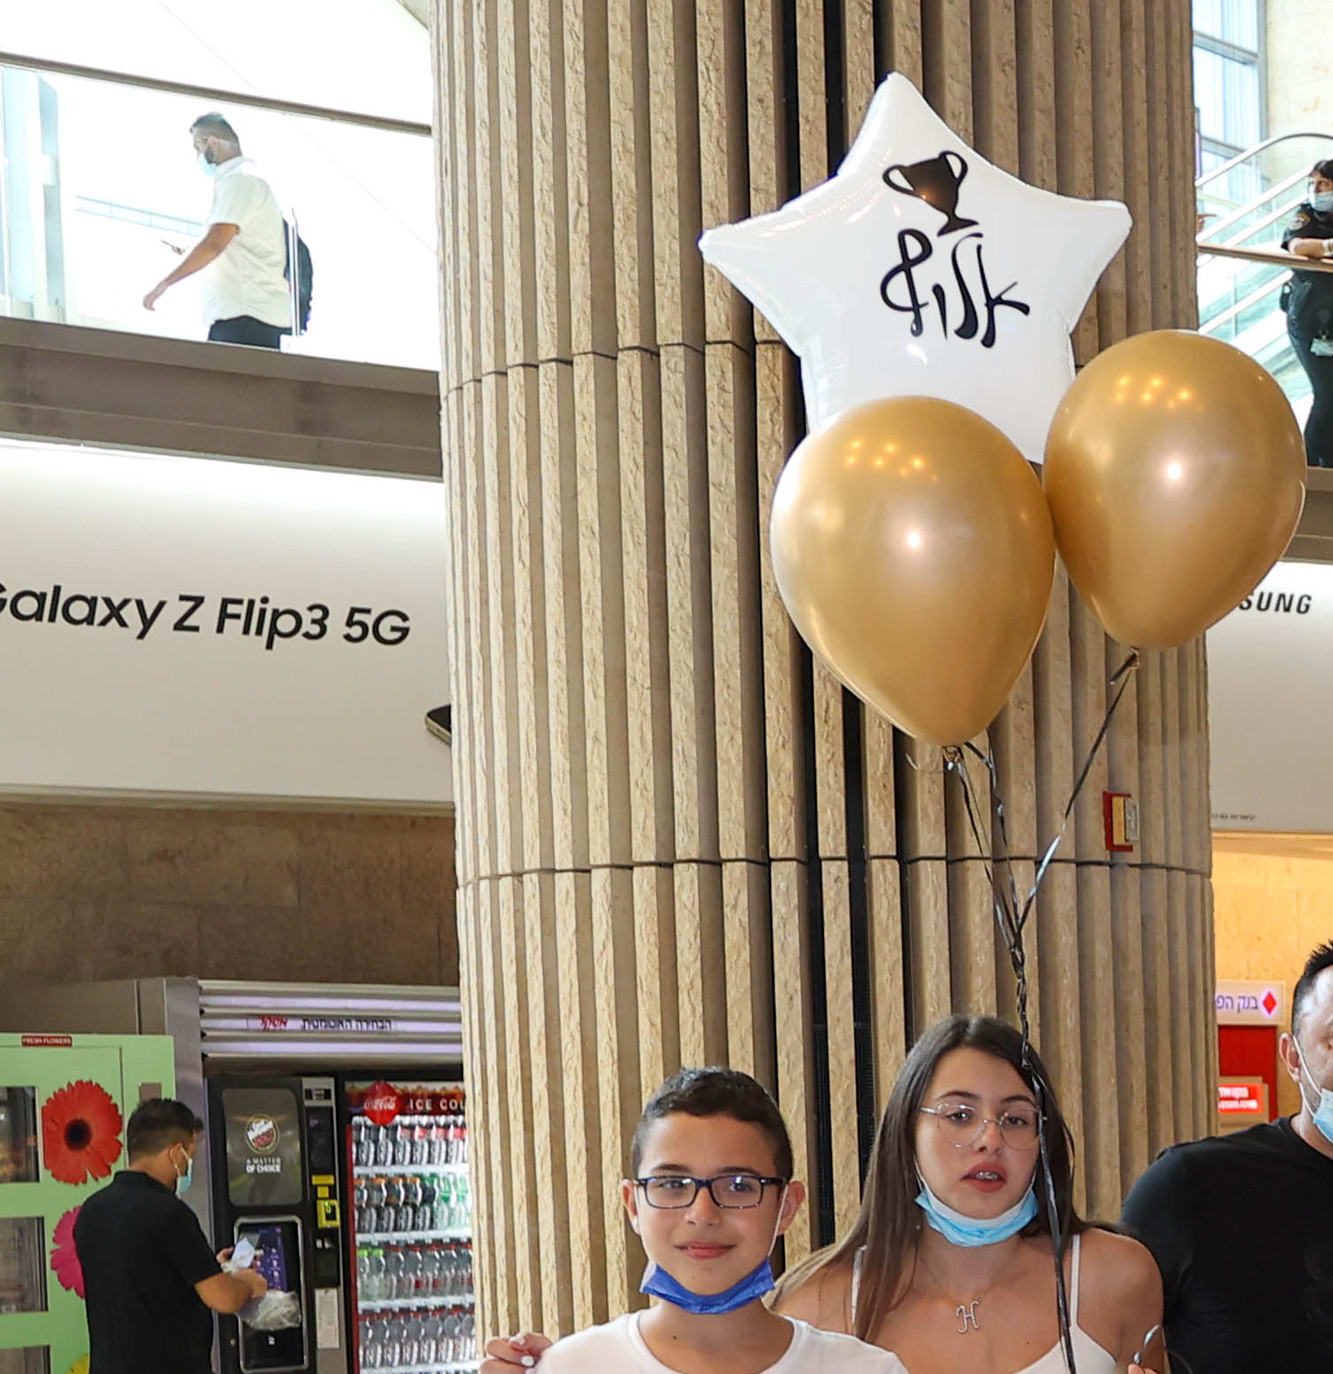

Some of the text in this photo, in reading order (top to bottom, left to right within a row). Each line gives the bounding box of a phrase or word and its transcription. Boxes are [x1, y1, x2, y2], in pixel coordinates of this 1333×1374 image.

[173, 594, 205, 633] Z
[215, 596, 330, 650] Flip3
[342, 606, 411, 646] 5G
[1237, 996, 1259, 1014] בנק
[409, 1098, 432, 1111] ICE
